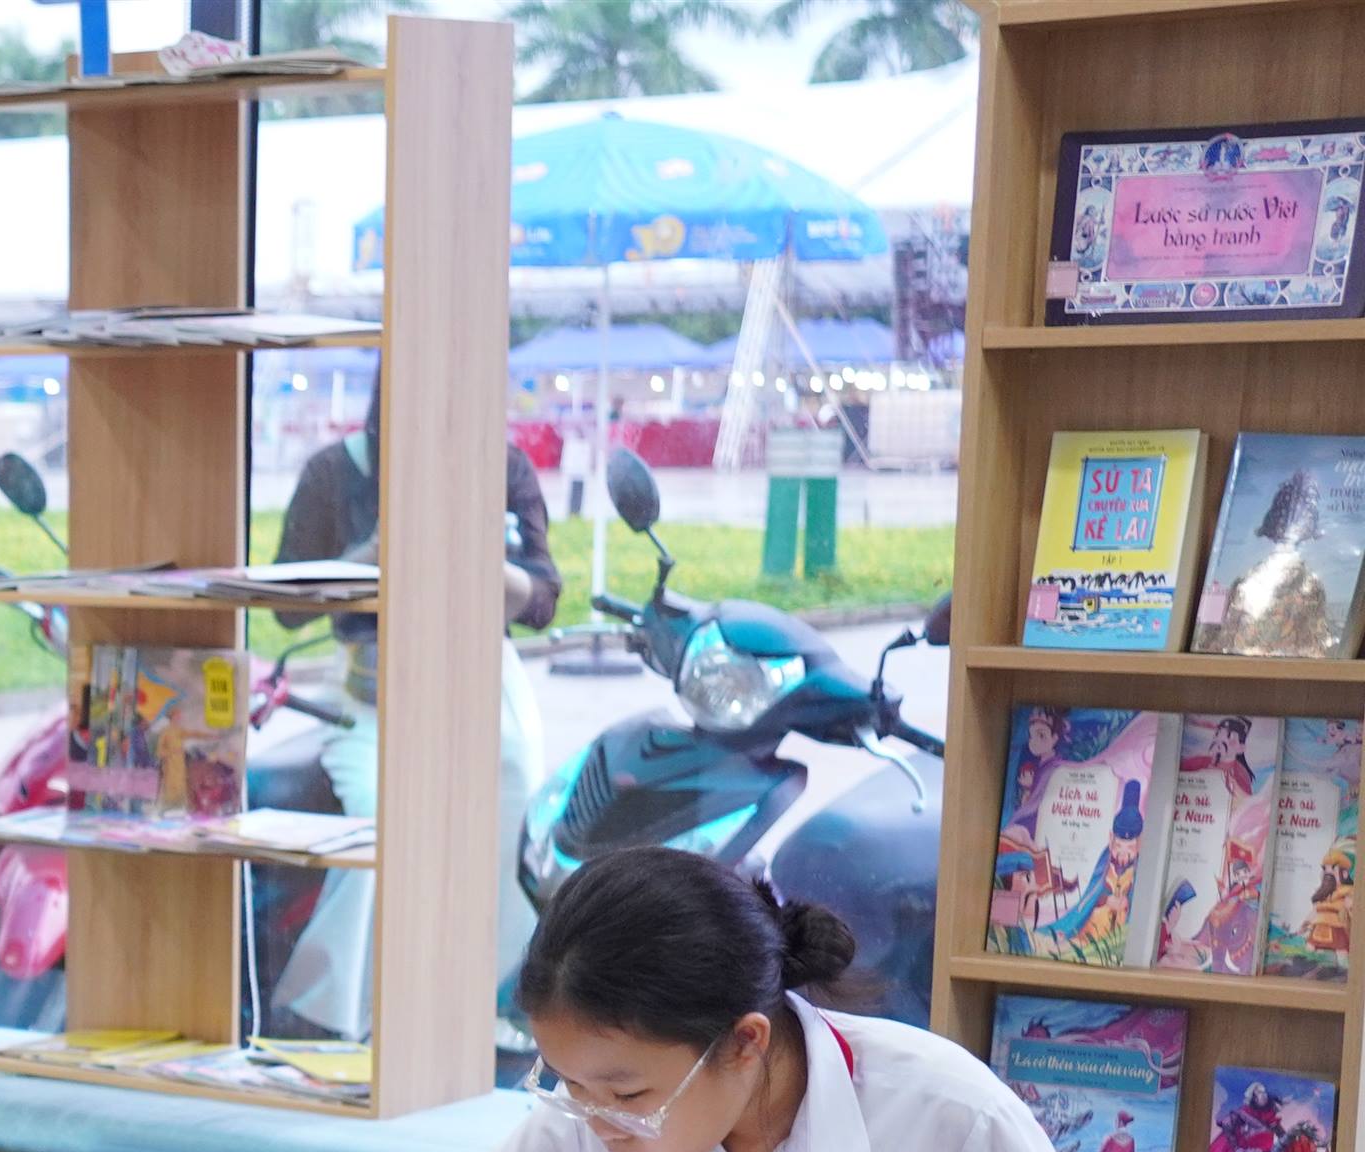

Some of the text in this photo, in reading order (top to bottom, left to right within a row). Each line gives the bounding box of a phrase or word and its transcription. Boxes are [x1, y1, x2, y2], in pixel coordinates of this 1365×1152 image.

[1133, 201, 1183, 226] Lược
[1215, 203, 1258, 222] nước
[1262, 196, 1300, 220] Việt
[1212, 225, 1262, 246] tranh
[1089, 463, 1153, 495] SỬ TA
[1174, 792, 1189, 807] ch
[1278, 796, 1294, 810] ch
[1077, 804, 1101, 819] Nam
[1184, 810, 1215, 825] Nam
[1290, 814, 1321, 829] Nam
